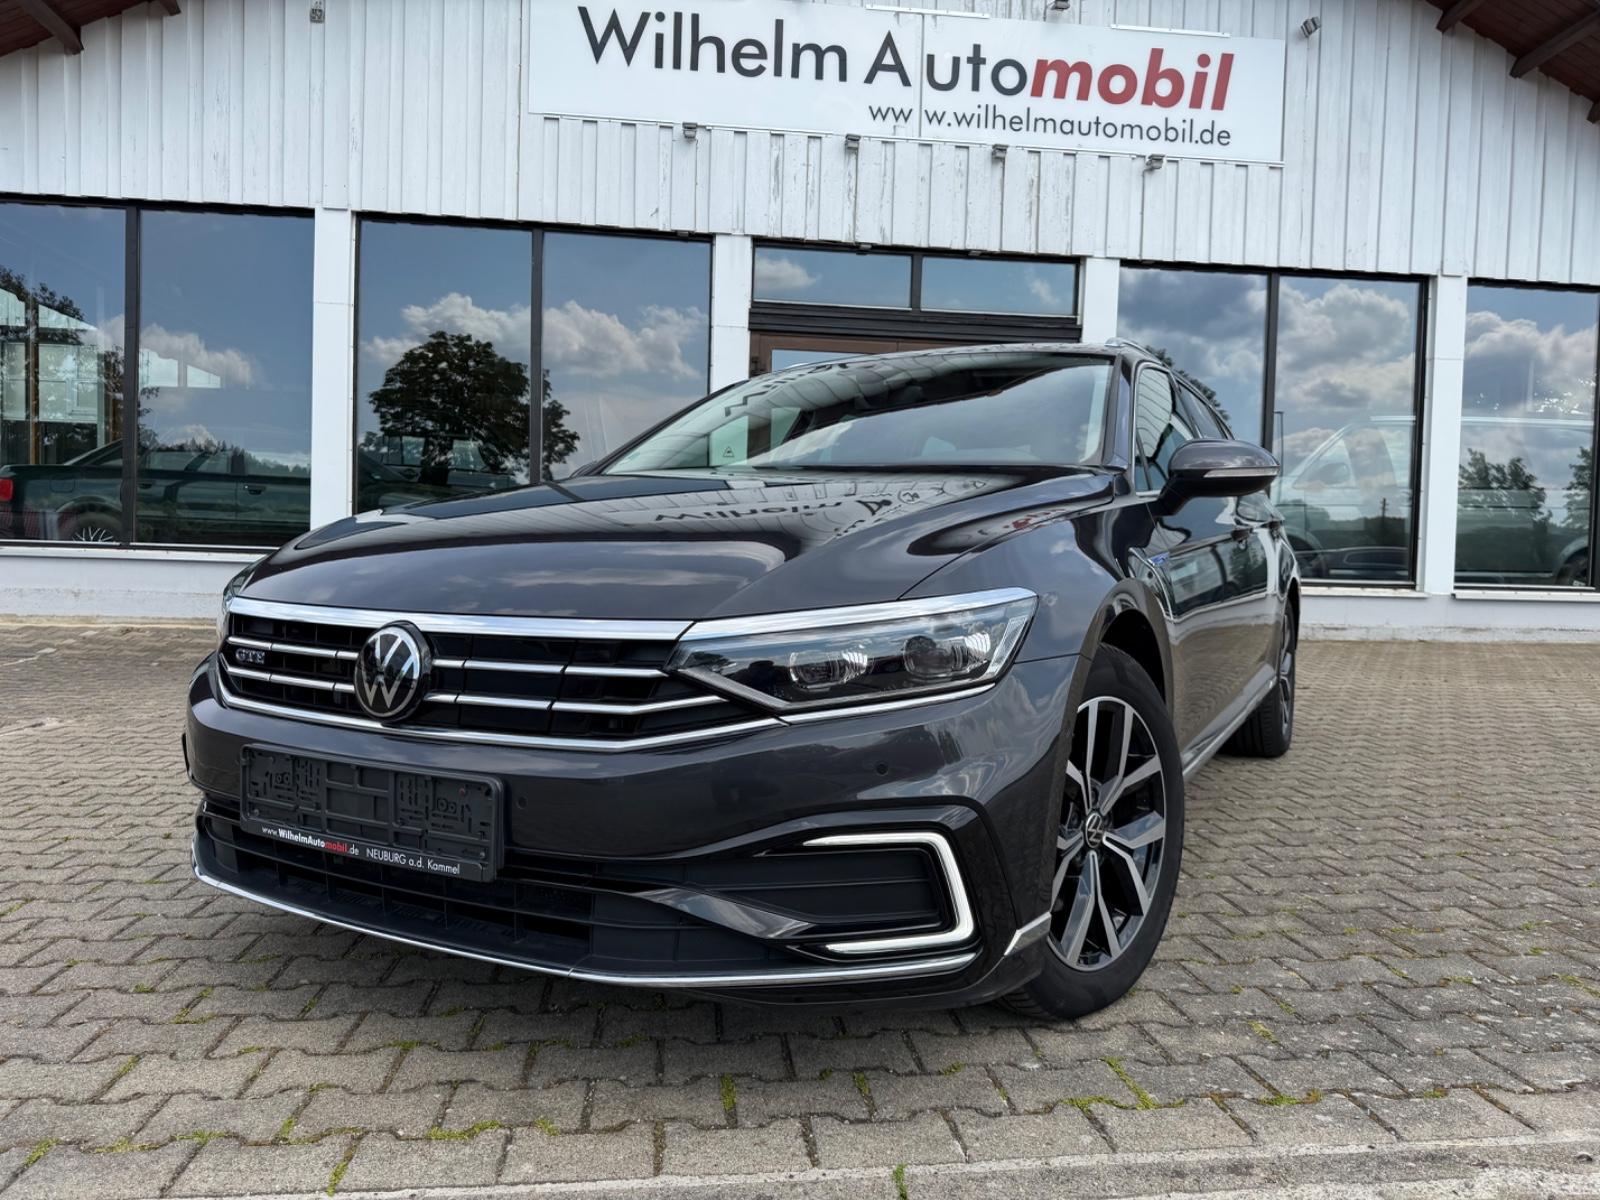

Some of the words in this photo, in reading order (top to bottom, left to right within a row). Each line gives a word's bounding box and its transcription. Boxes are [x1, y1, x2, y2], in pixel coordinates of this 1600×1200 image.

[578, 6, 847, 82] Wilhelm
[261, 825, 360, 856] www.WilhelmAutomobil.de
[366, 849, 406, 865] NEUBURG
[408, 858, 425, 868] a.d.
